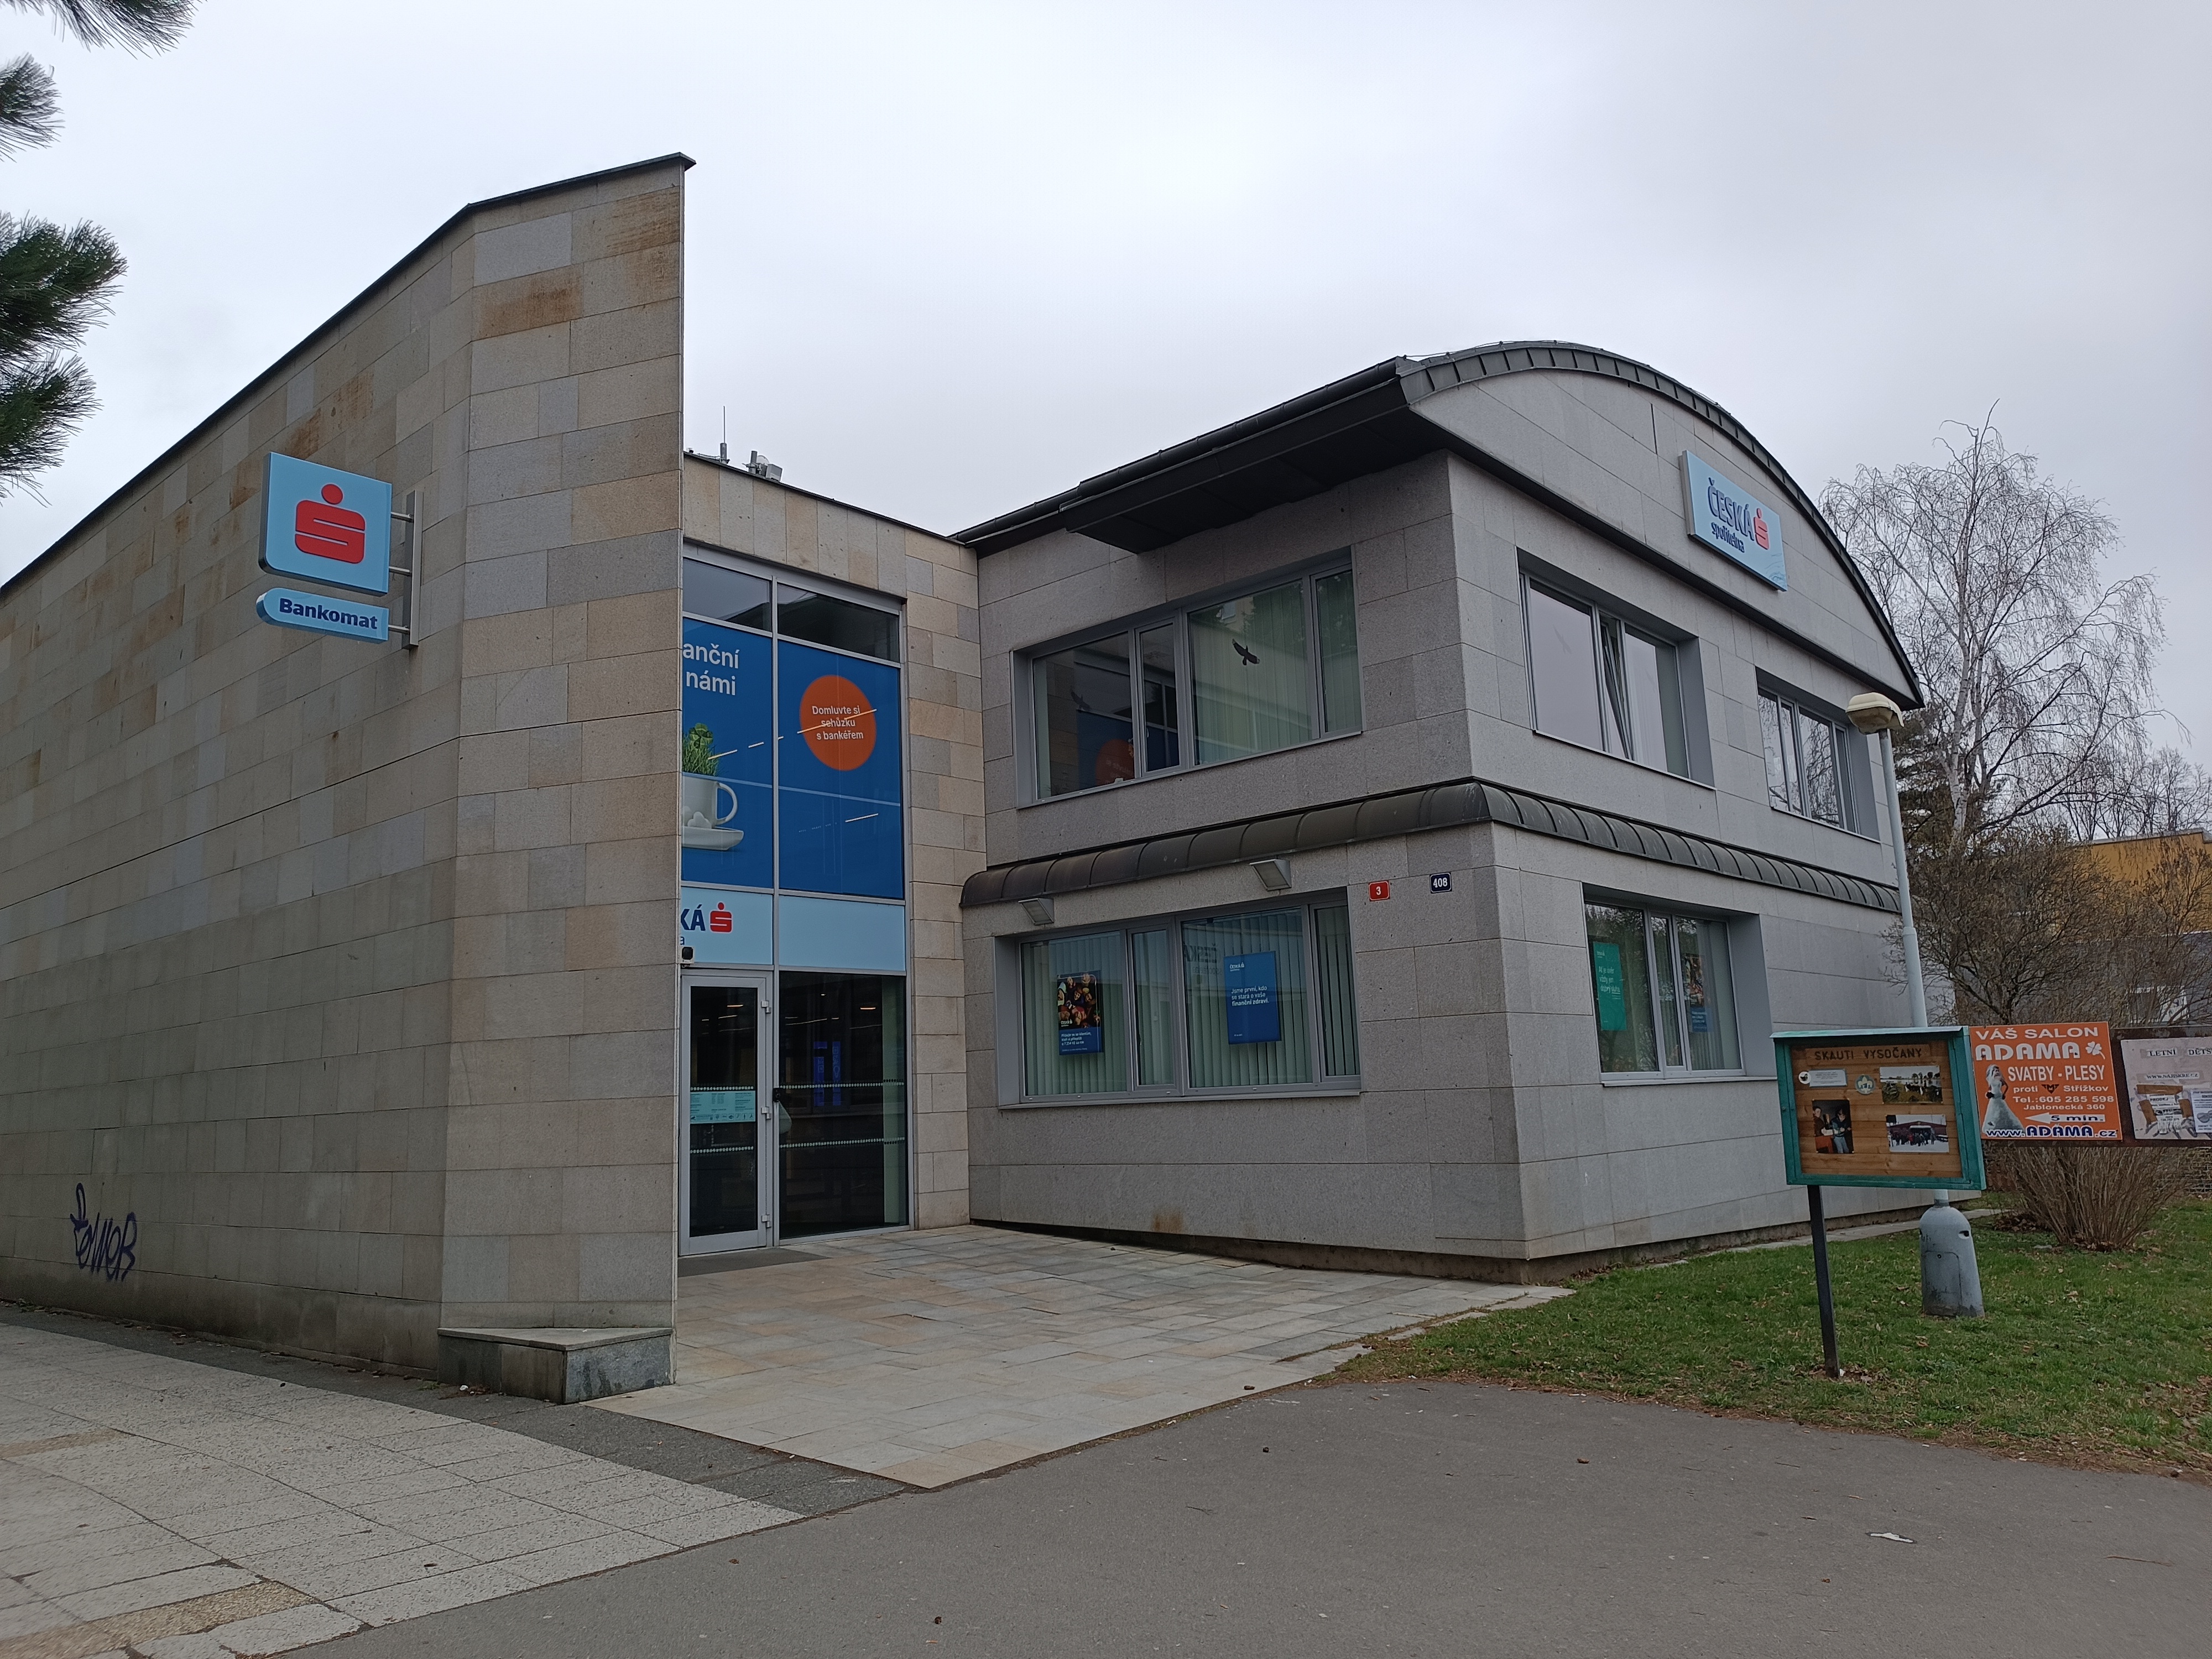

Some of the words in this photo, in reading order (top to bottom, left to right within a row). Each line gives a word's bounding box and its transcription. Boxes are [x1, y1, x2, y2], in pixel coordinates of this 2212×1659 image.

[1708, 477, 1754, 541] ČESKÁ
[279, 598, 378, 629] Bankomat
[686, 670, 735, 696] námi
[812, 705, 852, 715] Domluvte
[853, 705, 860, 714] si
[823, 730, 864, 740] bankéřem
[1433, 877, 1448, 888] 408
[1376, 886, 1381, 895] 3
[1975, 1027, 2018, 1040] VÁŠ
[2025, 1027, 2099, 1039] SALON
[1814, 1051, 1854, 1061] SKAUTI
[1863, 1046, 1922, 1060] VYSOČANY
[1975, 1042, 2080, 1061] ADAMA
[2008, 1066, 2054, 1082] SVATBY
[2065, 1065, 2105, 1081] PLESY
[2013, 1086, 2038, 1094] proti
[1986, 1126, 2117, 1137] www.ADAMA.cz
